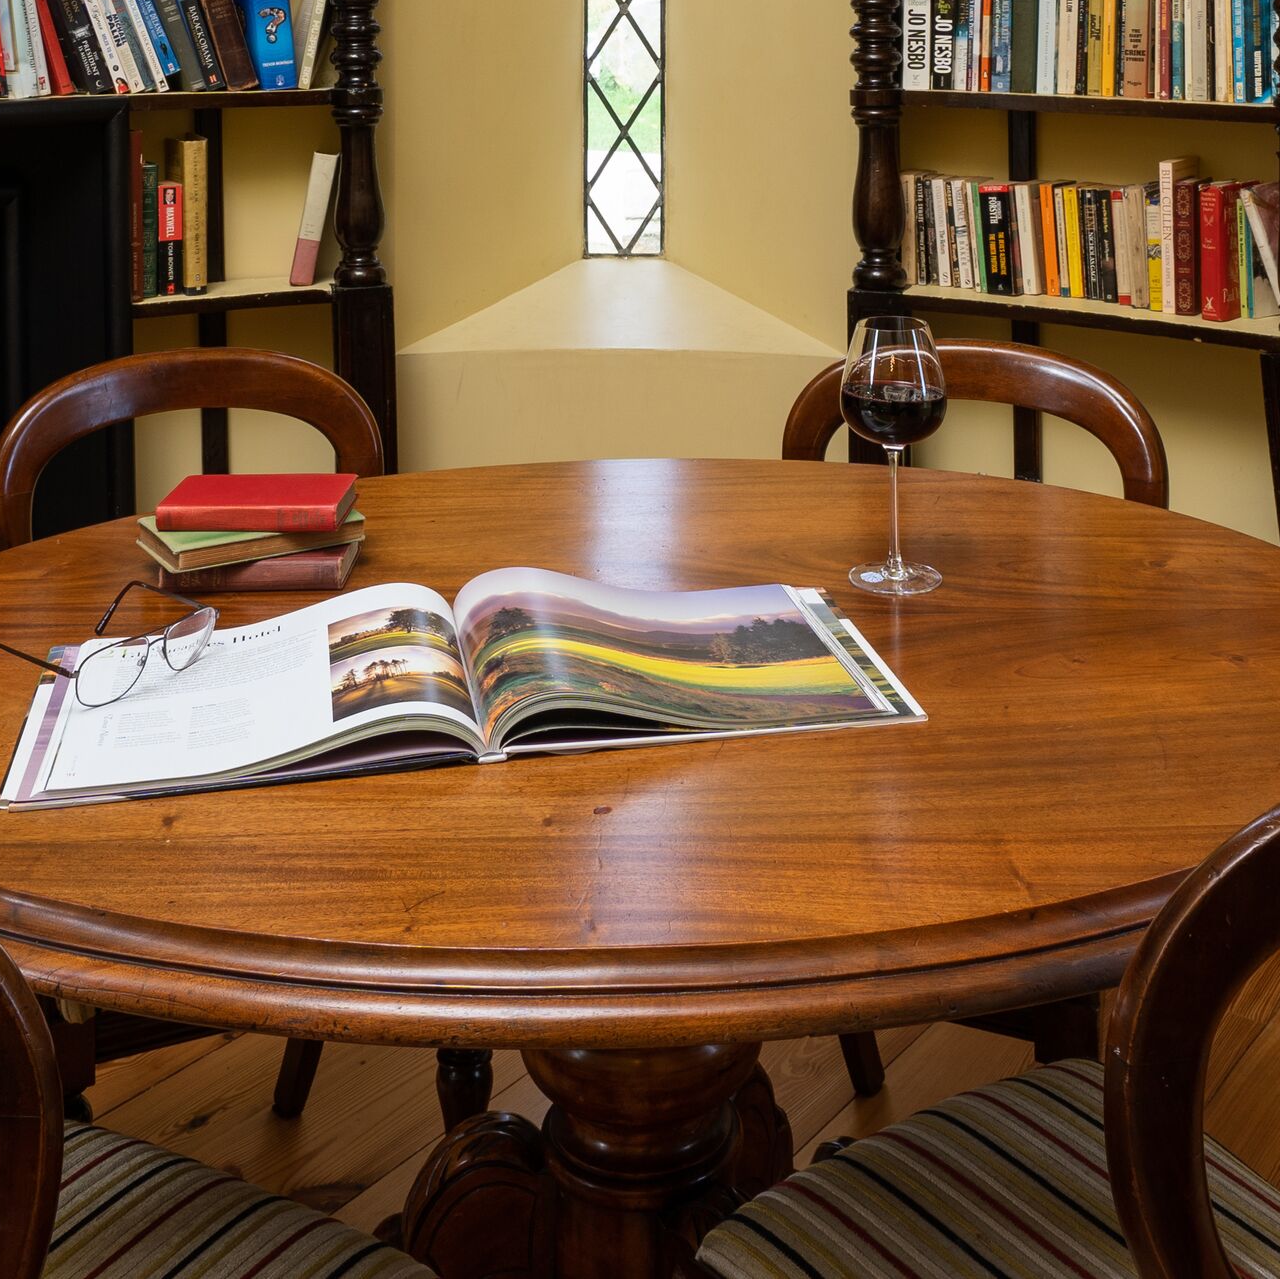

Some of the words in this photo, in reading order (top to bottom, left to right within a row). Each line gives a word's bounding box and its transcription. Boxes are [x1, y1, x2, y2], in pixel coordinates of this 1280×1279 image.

[908, 9, 926, 26] JO
[188, 5, 204, 38] BARACK
[197, 36, 215, 70] OBAMA
[907, 28, 926, 70] NESBO
[1162, 169, 1170, 190] BILL
[165, 206, 174, 238] MAXWELL
[1163, 193, 1172, 241] CULLEN
